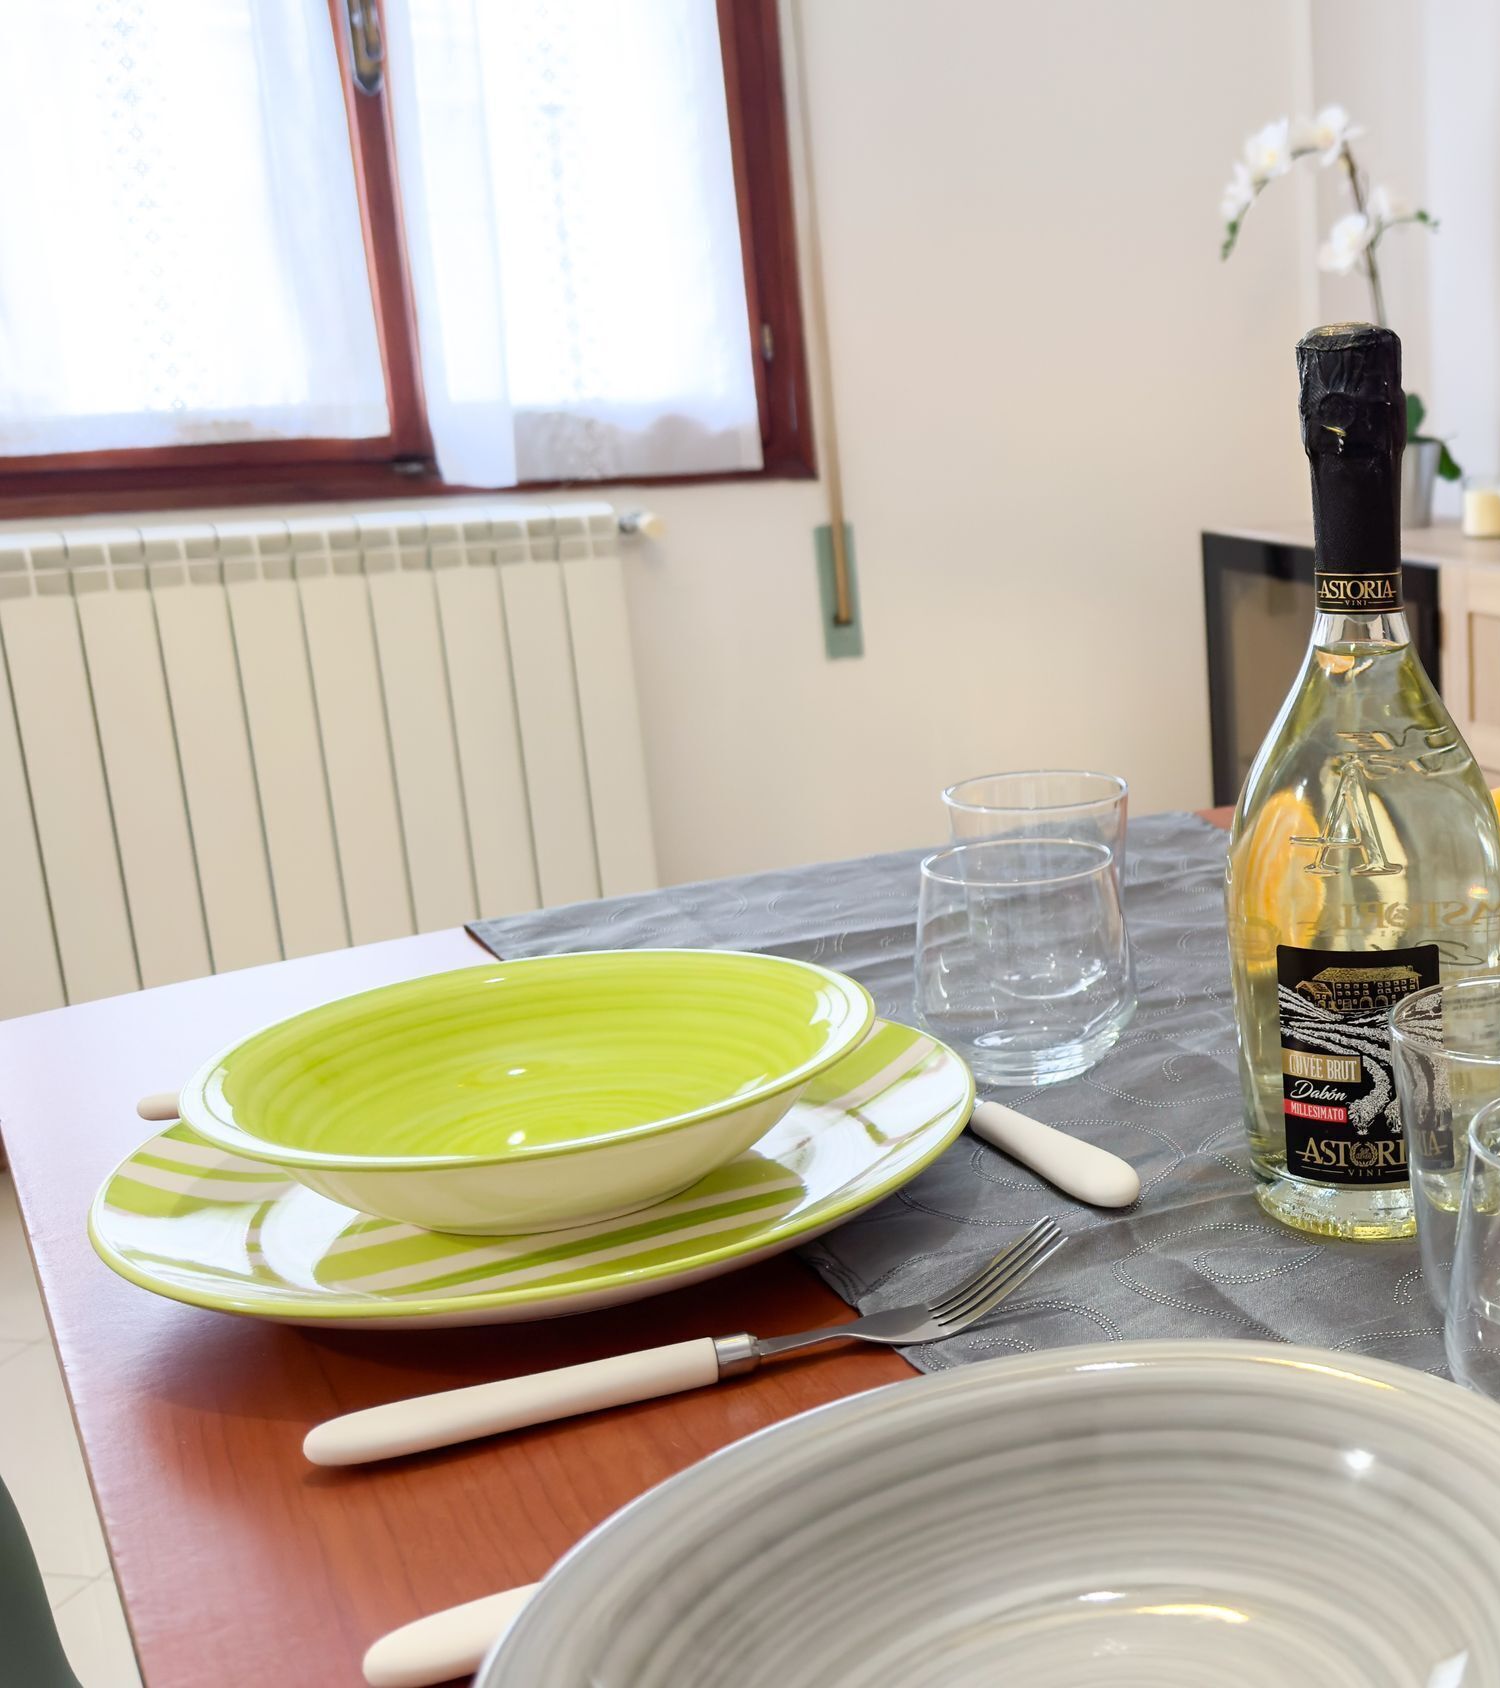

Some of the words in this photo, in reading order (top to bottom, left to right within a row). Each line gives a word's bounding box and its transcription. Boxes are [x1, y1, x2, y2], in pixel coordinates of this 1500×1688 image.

[1317, 579, 1397, 600] ASTORIA
[1289, 1052, 1324, 1080] CUVÉE
[1327, 1057, 1358, 1081] BRUT
[1290, 1080, 1348, 1101] Dabón
[1290, 1101, 1345, 1121] MILLESIMATO
[1349, 1168, 1383, 1177] VINI
